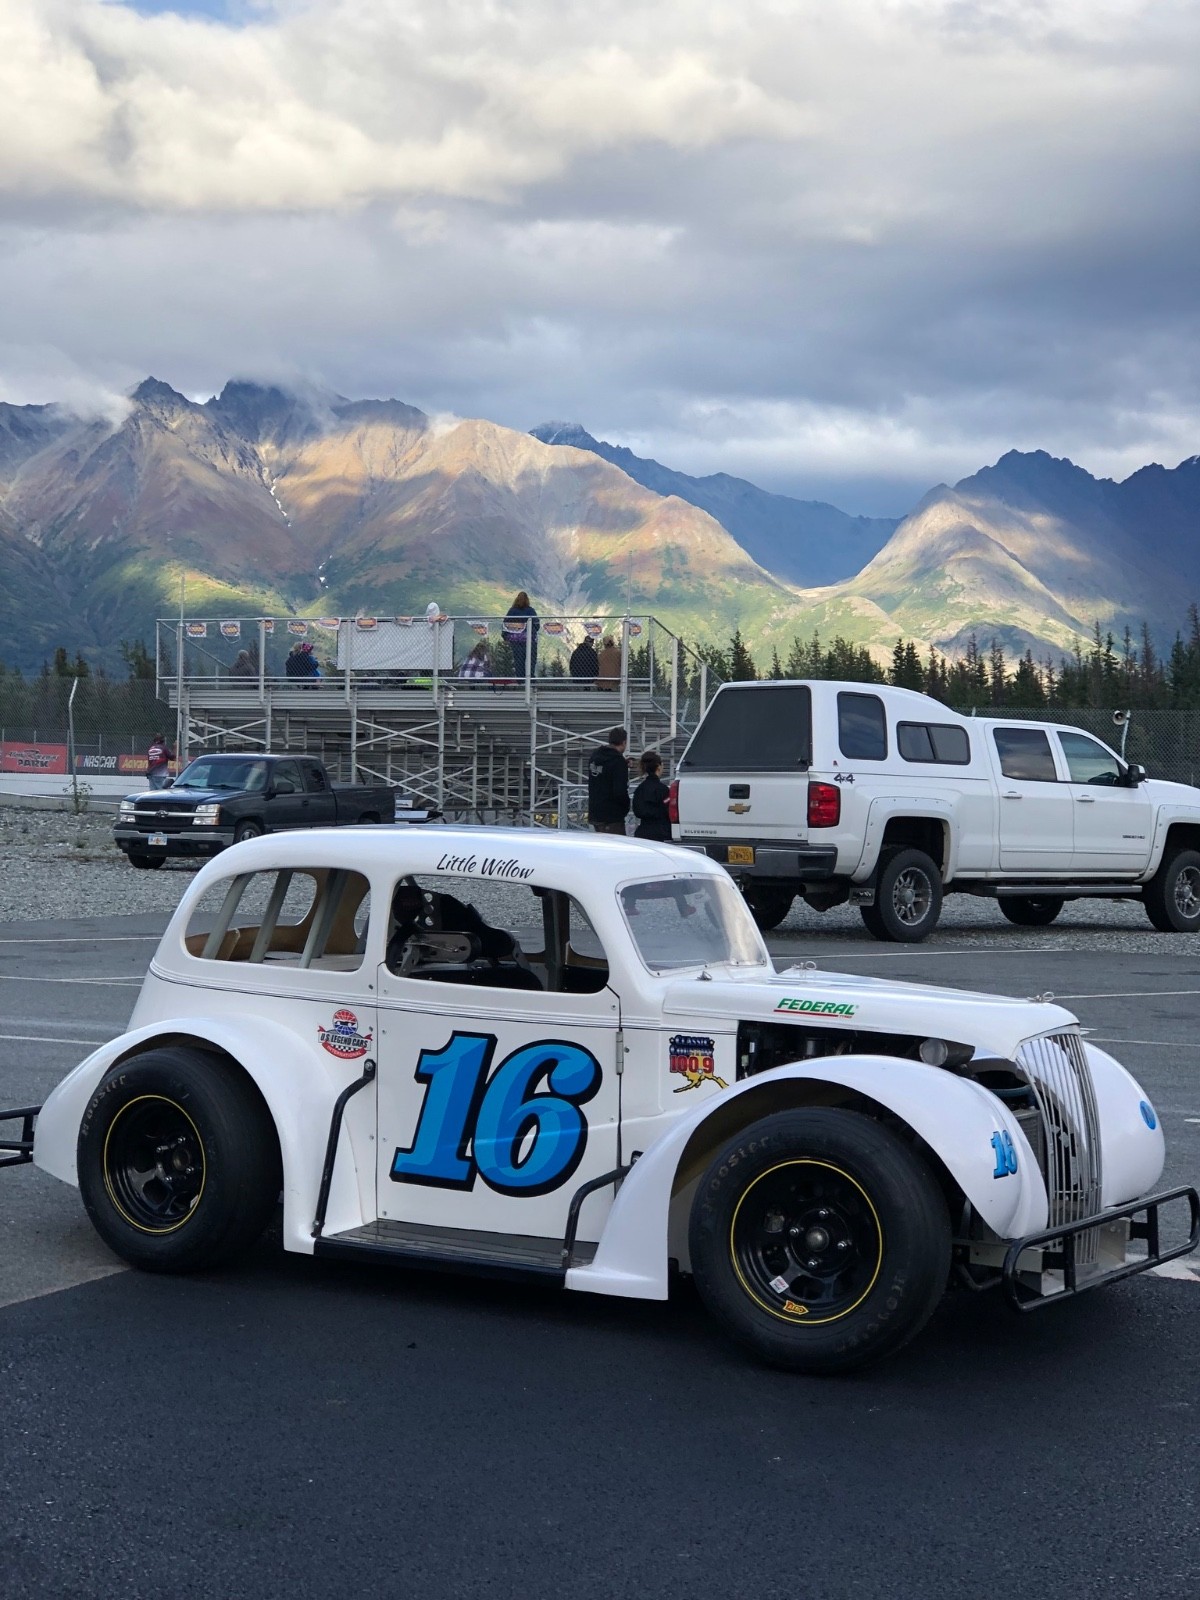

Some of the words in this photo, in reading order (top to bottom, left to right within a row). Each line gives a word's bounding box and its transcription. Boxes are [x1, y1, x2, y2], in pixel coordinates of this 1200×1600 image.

[18, 759, 49, 768] PARK
[83, 755, 117, 768] NASCAR
[436, 853, 477, 873] Little
[481, 858, 535, 879] Willow
[777, 998, 855, 1015] FEDERAL
[331, 1035, 352, 1045] LEGEND
[352, 1038, 368, 1048] CARS
[389, 1030, 603, 1198] 16
[990, 1129, 1018, 1179] 16
